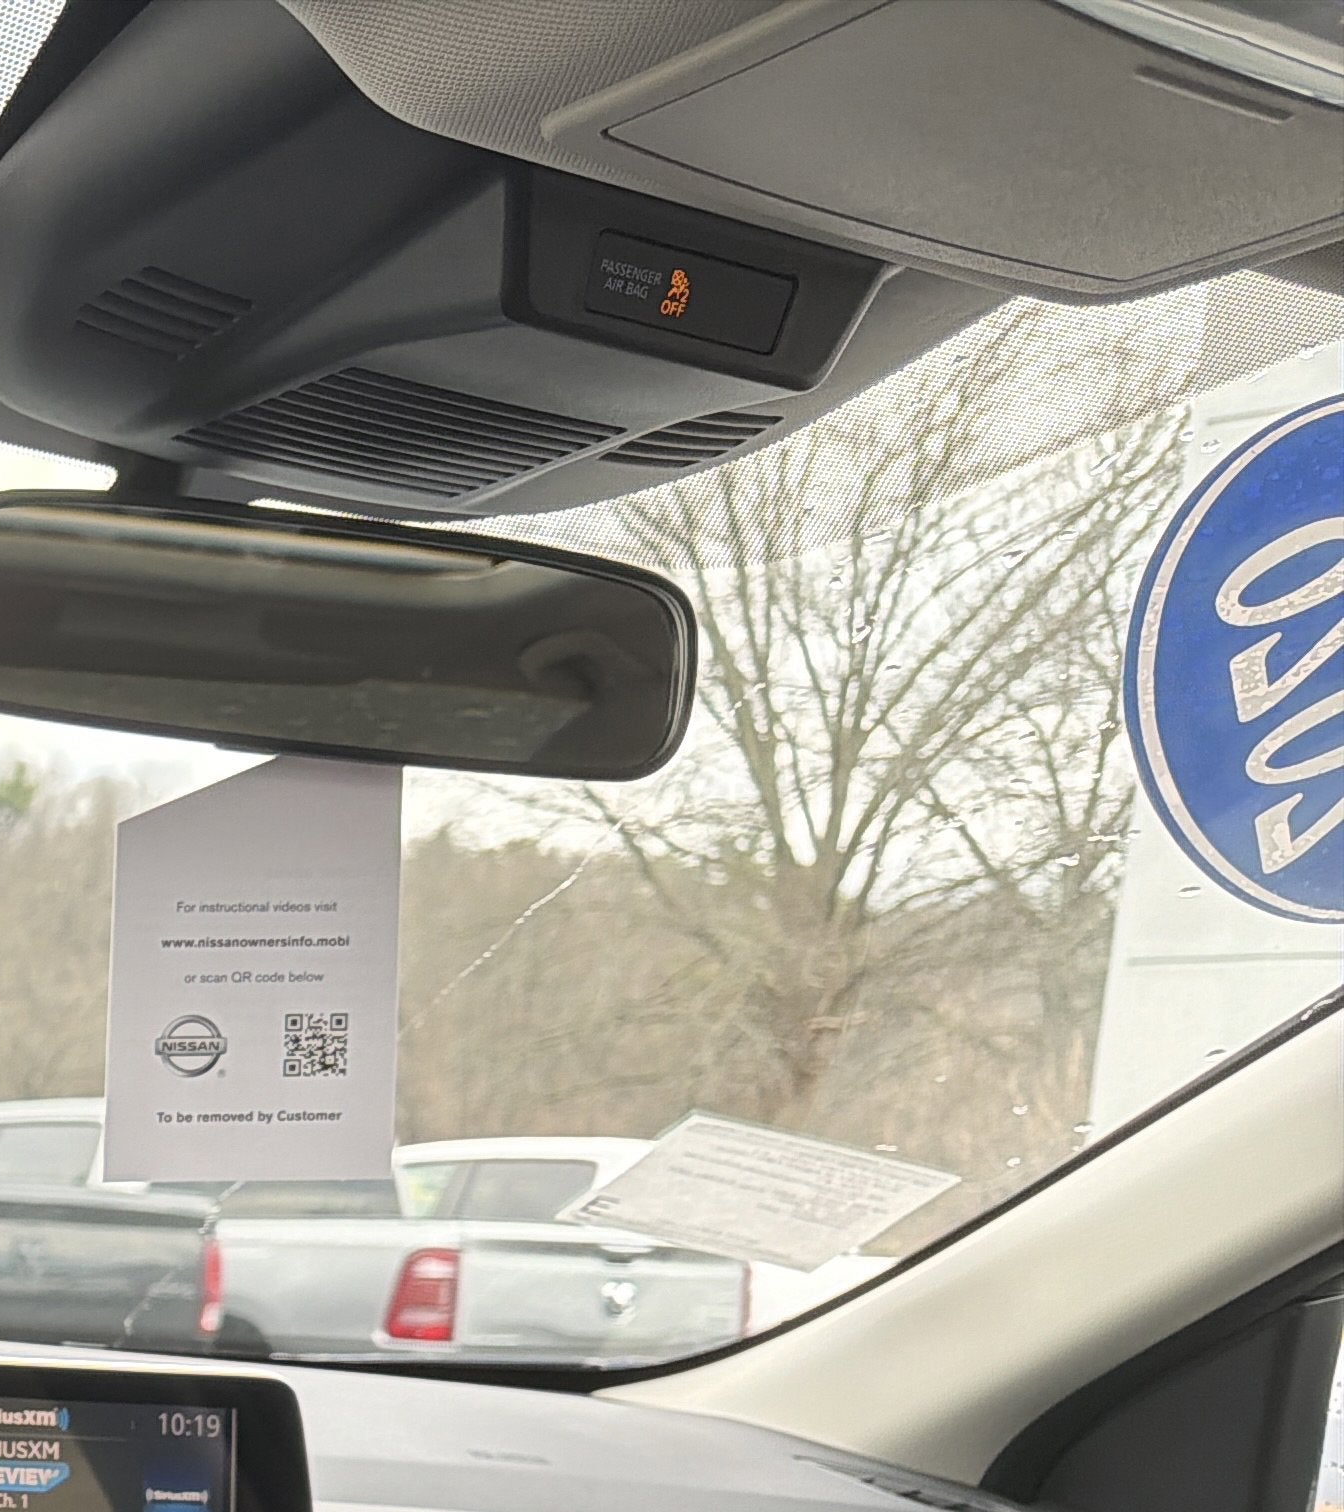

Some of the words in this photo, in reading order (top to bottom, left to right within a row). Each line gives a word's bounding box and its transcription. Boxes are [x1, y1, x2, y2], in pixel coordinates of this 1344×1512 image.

[600, 258, 663, 286] PASSENGER
[603, 277, 624, 294] AIR
[626, 281, 649, 300] BAG
[660, 299, 687, 318] OFF
[176, 902, 196, 913] For
[199, 902, 269, 913] instructional
[273, 902, 311, 913] videos
[314, 902, 337, 913] visit
[161, 936, 350, 948] www.nissanownersinfo.mobi
[184, 974, 196, 983] or
[200, 974, 228, 983] scan
[231, 972, 252, 984] QR
[255, 972, 285, 983] code
[288, 972, 324, 983] below
[161, 1041, 220, 1052] NISSAN
[157, 1112, 172, 1123] To
[176, 1112, 193, 1123] be
[197, 1111, 253, 1122] removed
[258, 1111, 273, 1124] by
[277, 1111, 343, 1122] Customer
[158, 1413, 221, 1438] 10:19
[22, 1494, 28, 1509] 1
